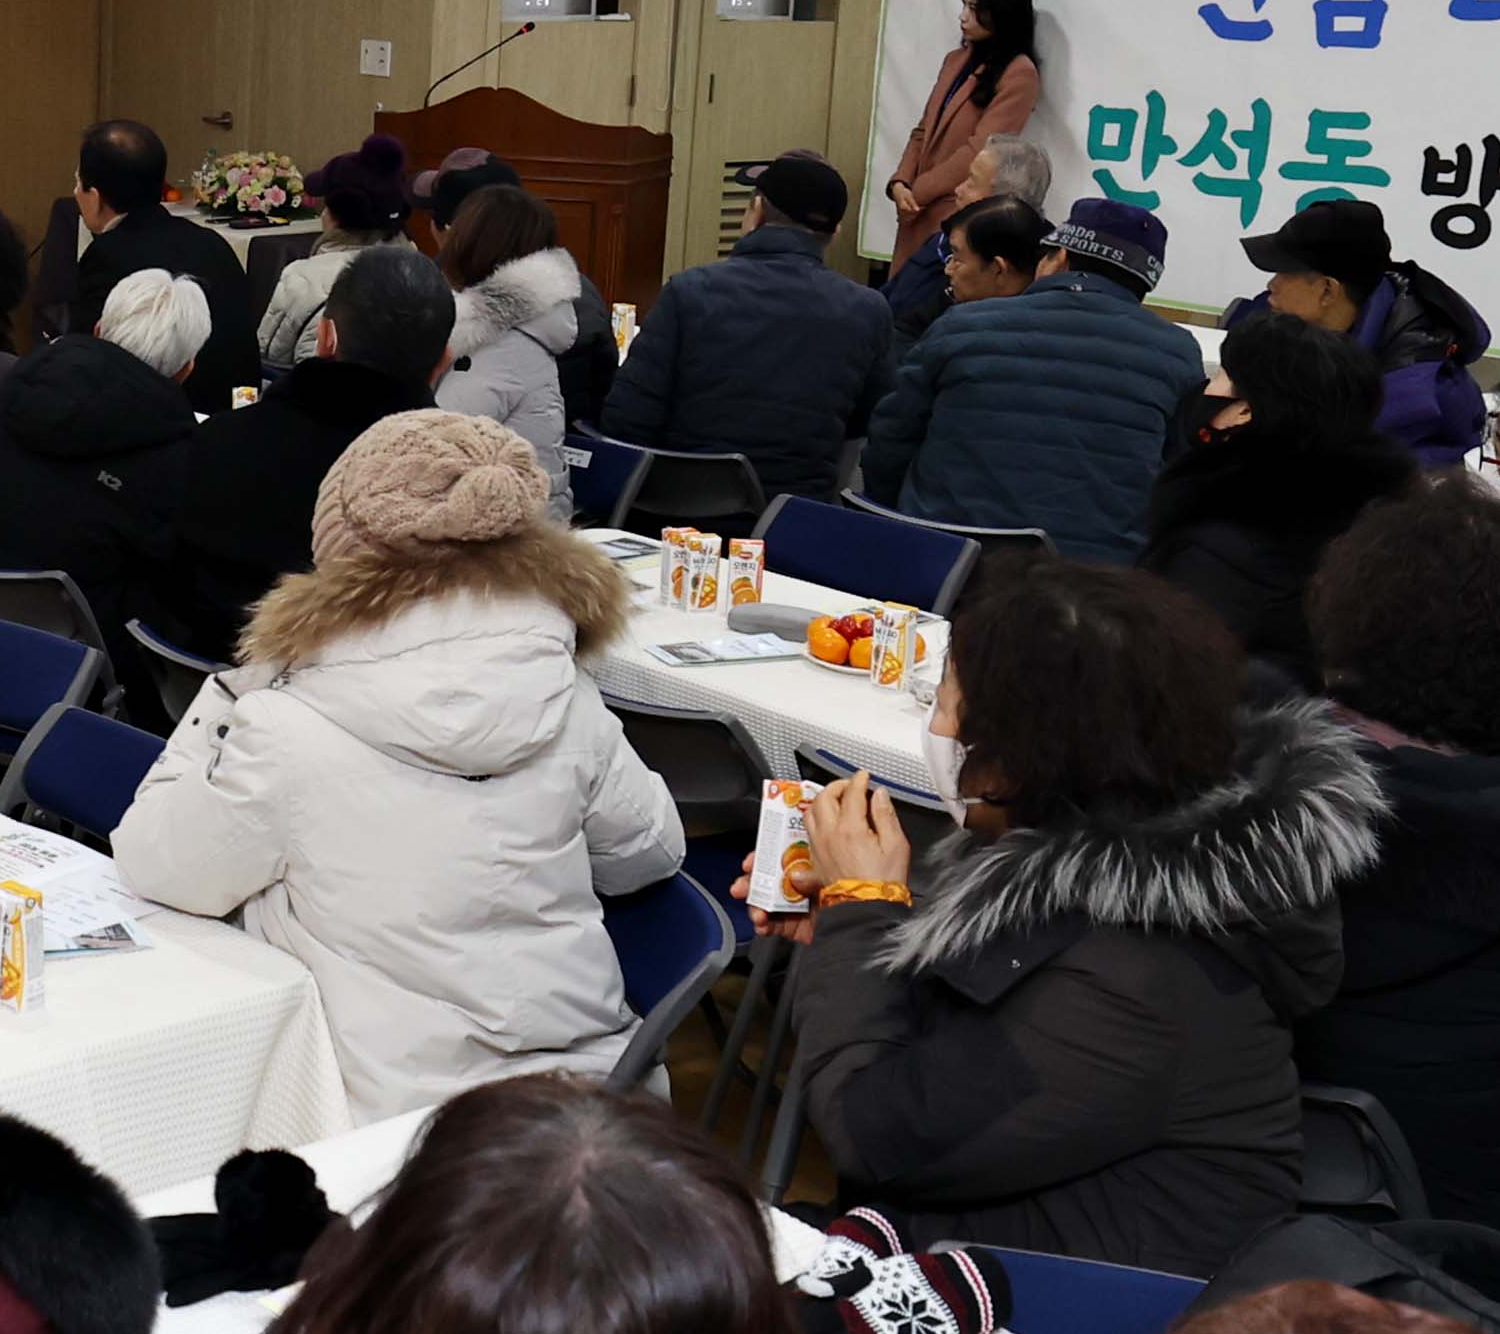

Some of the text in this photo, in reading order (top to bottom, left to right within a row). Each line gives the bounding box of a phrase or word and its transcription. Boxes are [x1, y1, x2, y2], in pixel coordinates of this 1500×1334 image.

[1087, 89, 1392, 229] 만석동
[1059, 233, 1125, 262] SPORTS
[734, 561, 756, 571] 오렌지
